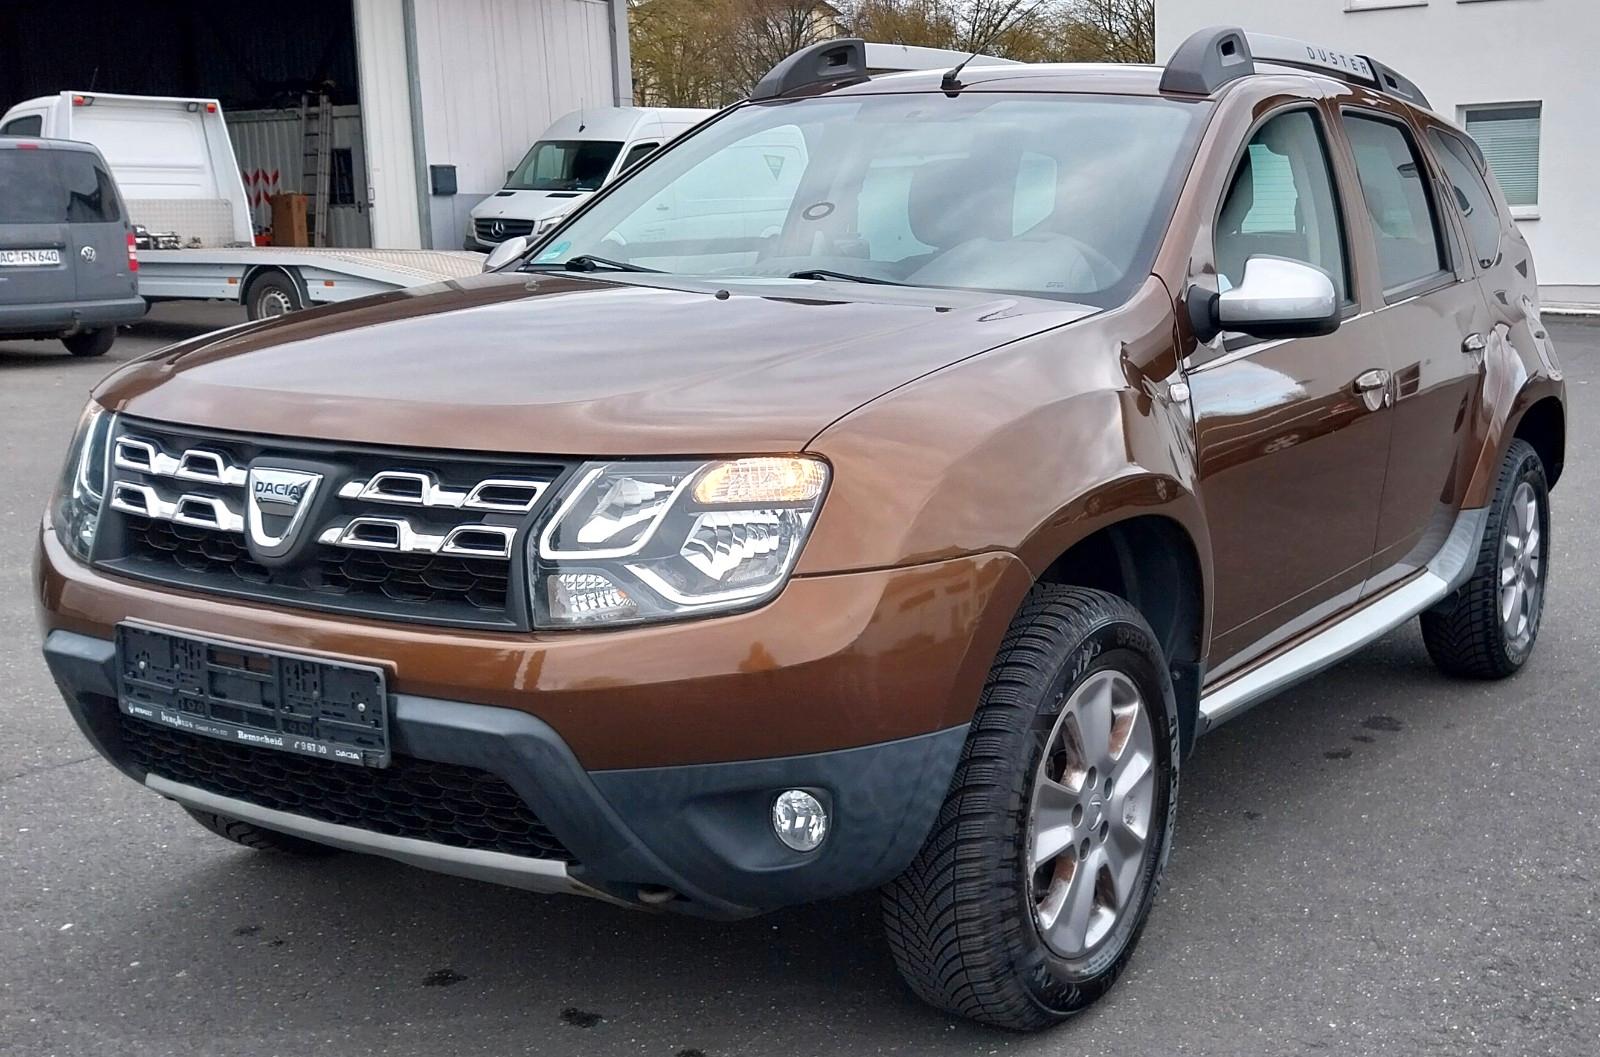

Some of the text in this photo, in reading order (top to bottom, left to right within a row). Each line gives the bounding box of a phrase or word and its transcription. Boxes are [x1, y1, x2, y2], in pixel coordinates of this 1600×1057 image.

[1306, 46, 1369, 75] DUSTER
[0, 251, 58, 263] AC FN 640
[255, 481, 300, 496] DACIA
[236, 730, 284, 746] Remscheid
[335, 749, 360, 760] DACIA
